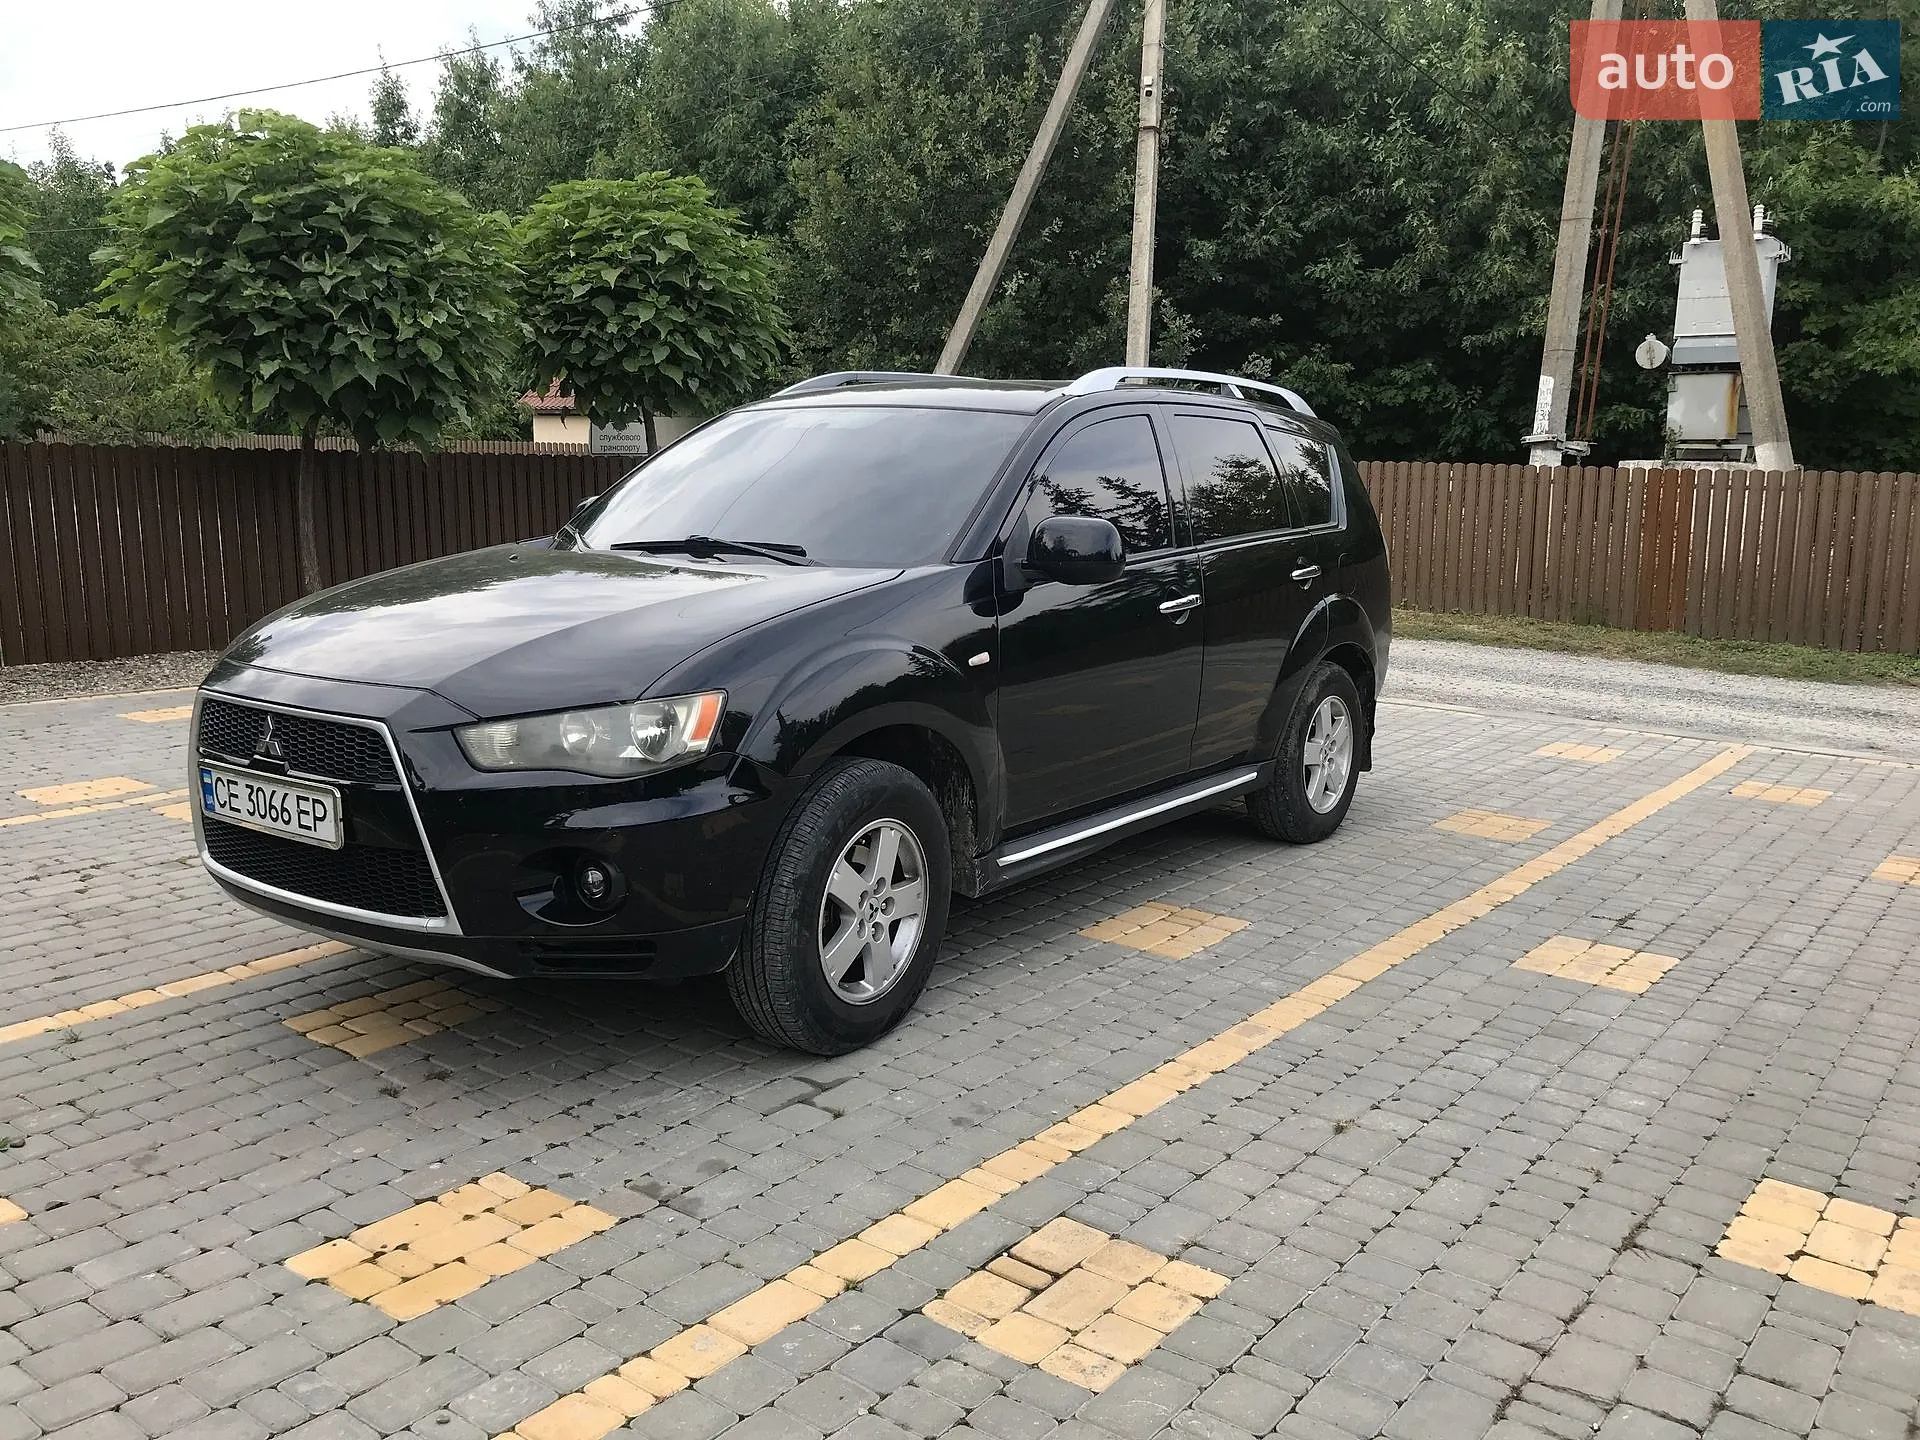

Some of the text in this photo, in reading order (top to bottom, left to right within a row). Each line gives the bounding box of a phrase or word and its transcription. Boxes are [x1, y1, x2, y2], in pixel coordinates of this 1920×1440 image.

[599, 433, 641, 442] службового
[215, 776, 327, 832] CE 3066 EP
